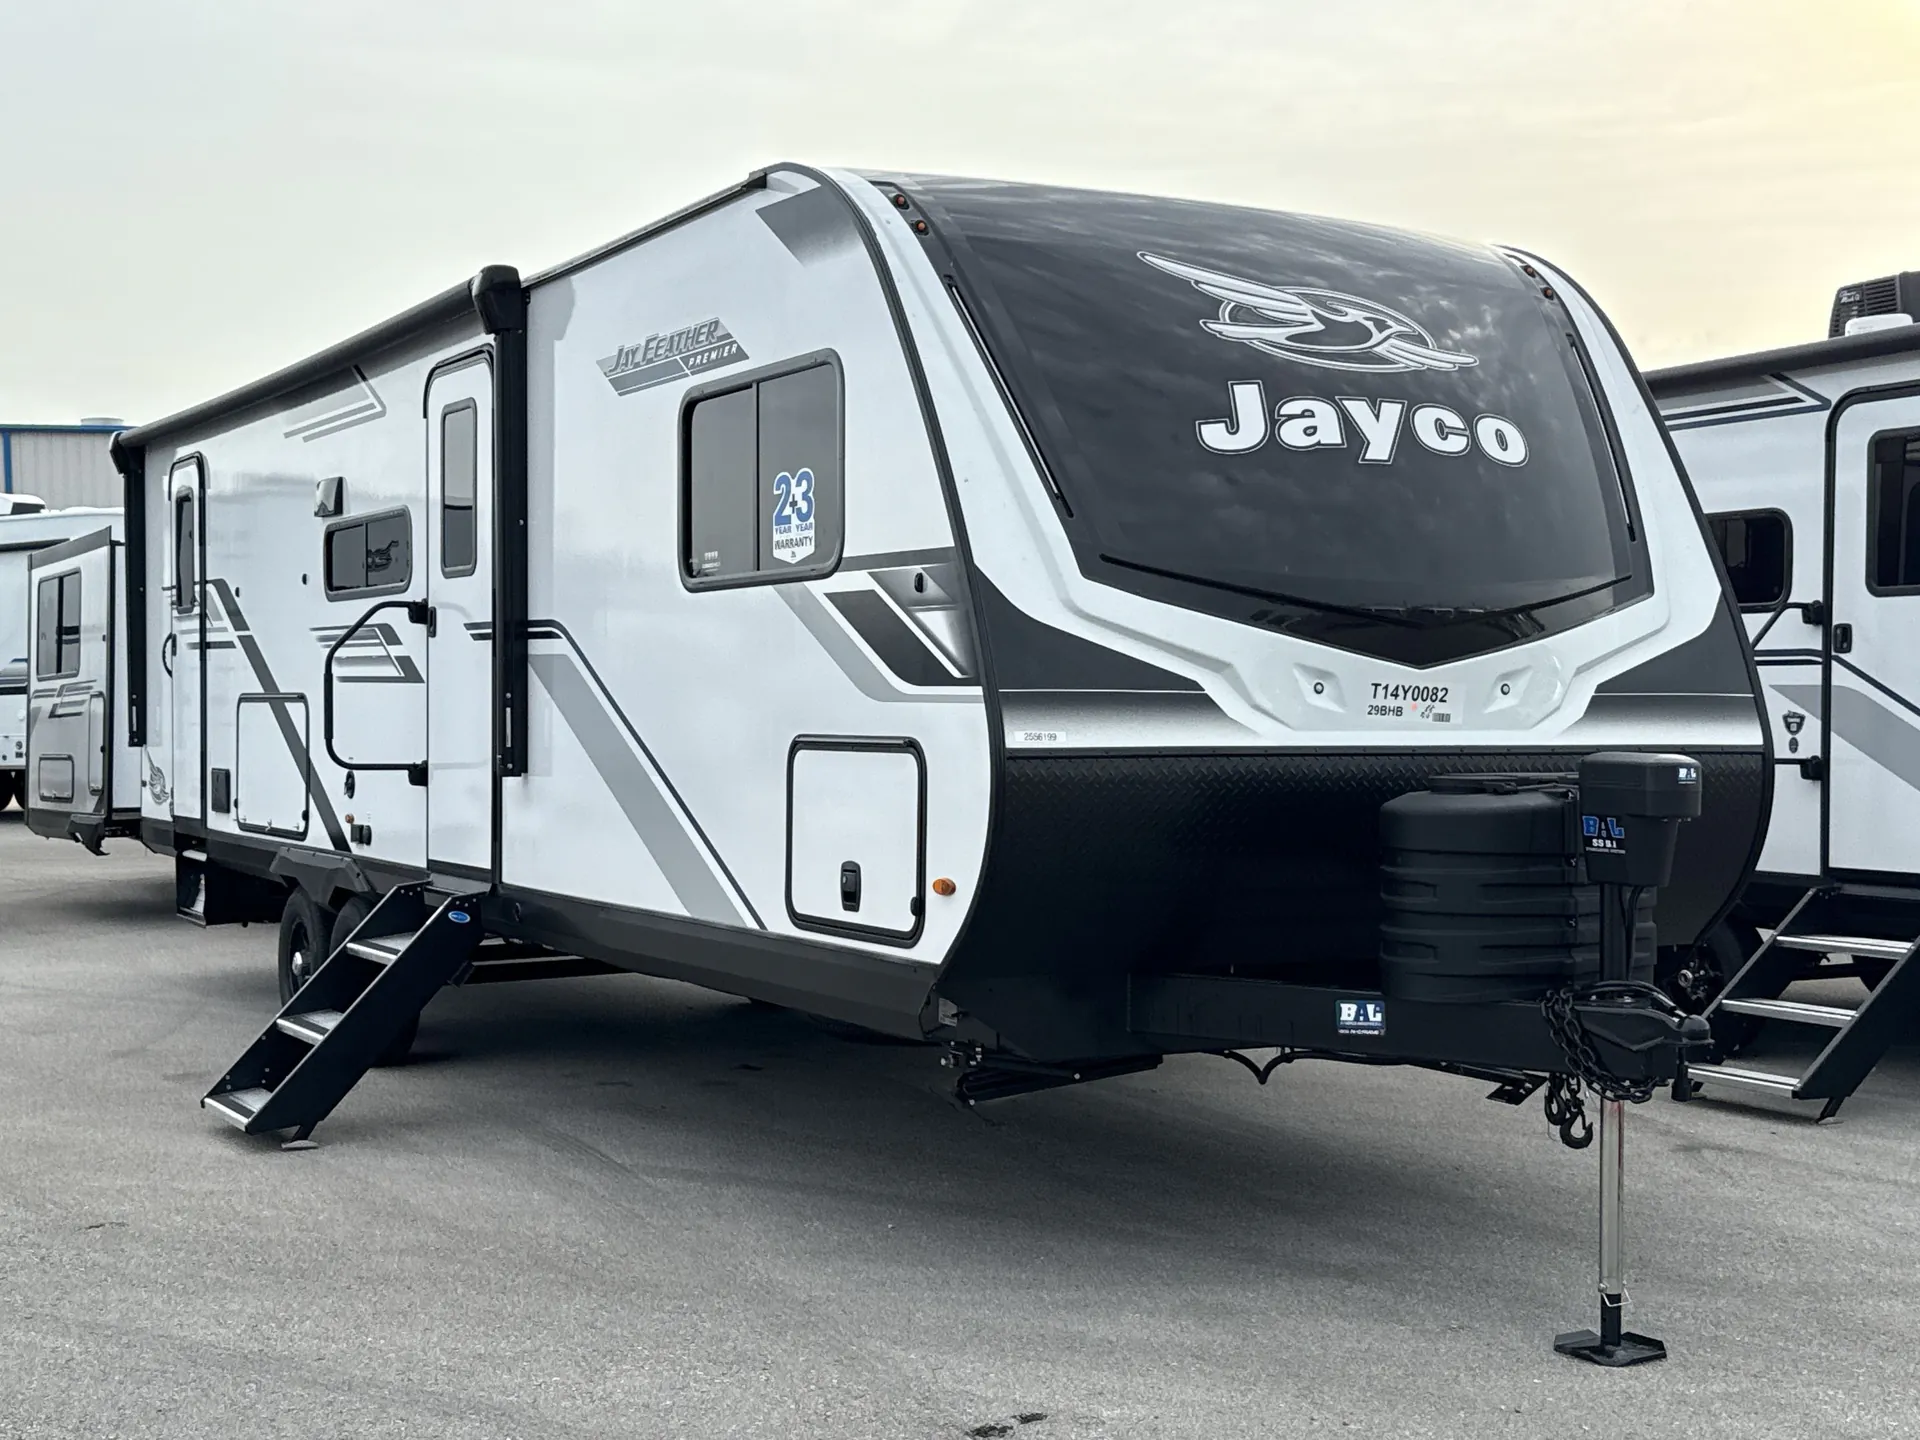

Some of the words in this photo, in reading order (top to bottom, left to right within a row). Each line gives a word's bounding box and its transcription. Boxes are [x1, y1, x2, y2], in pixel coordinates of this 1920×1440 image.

[607, 344, 641, 373] JAY
[641, 317, 720, 365] FEATHER
[688, 343, 738, 369] PREMIER
[1196, 380, 1530, 468] Jayco
[775, 525, 792, 535] YEAR
[796, 522, 813, 532] YEAR
[774, 535, 814, 550] WARRANTY
[1371, 683, 1449, 703] T14Y0082
[1367, 705, 1404, 717] 29BHB
[1340, 1003, 1382, 1022] BAL
